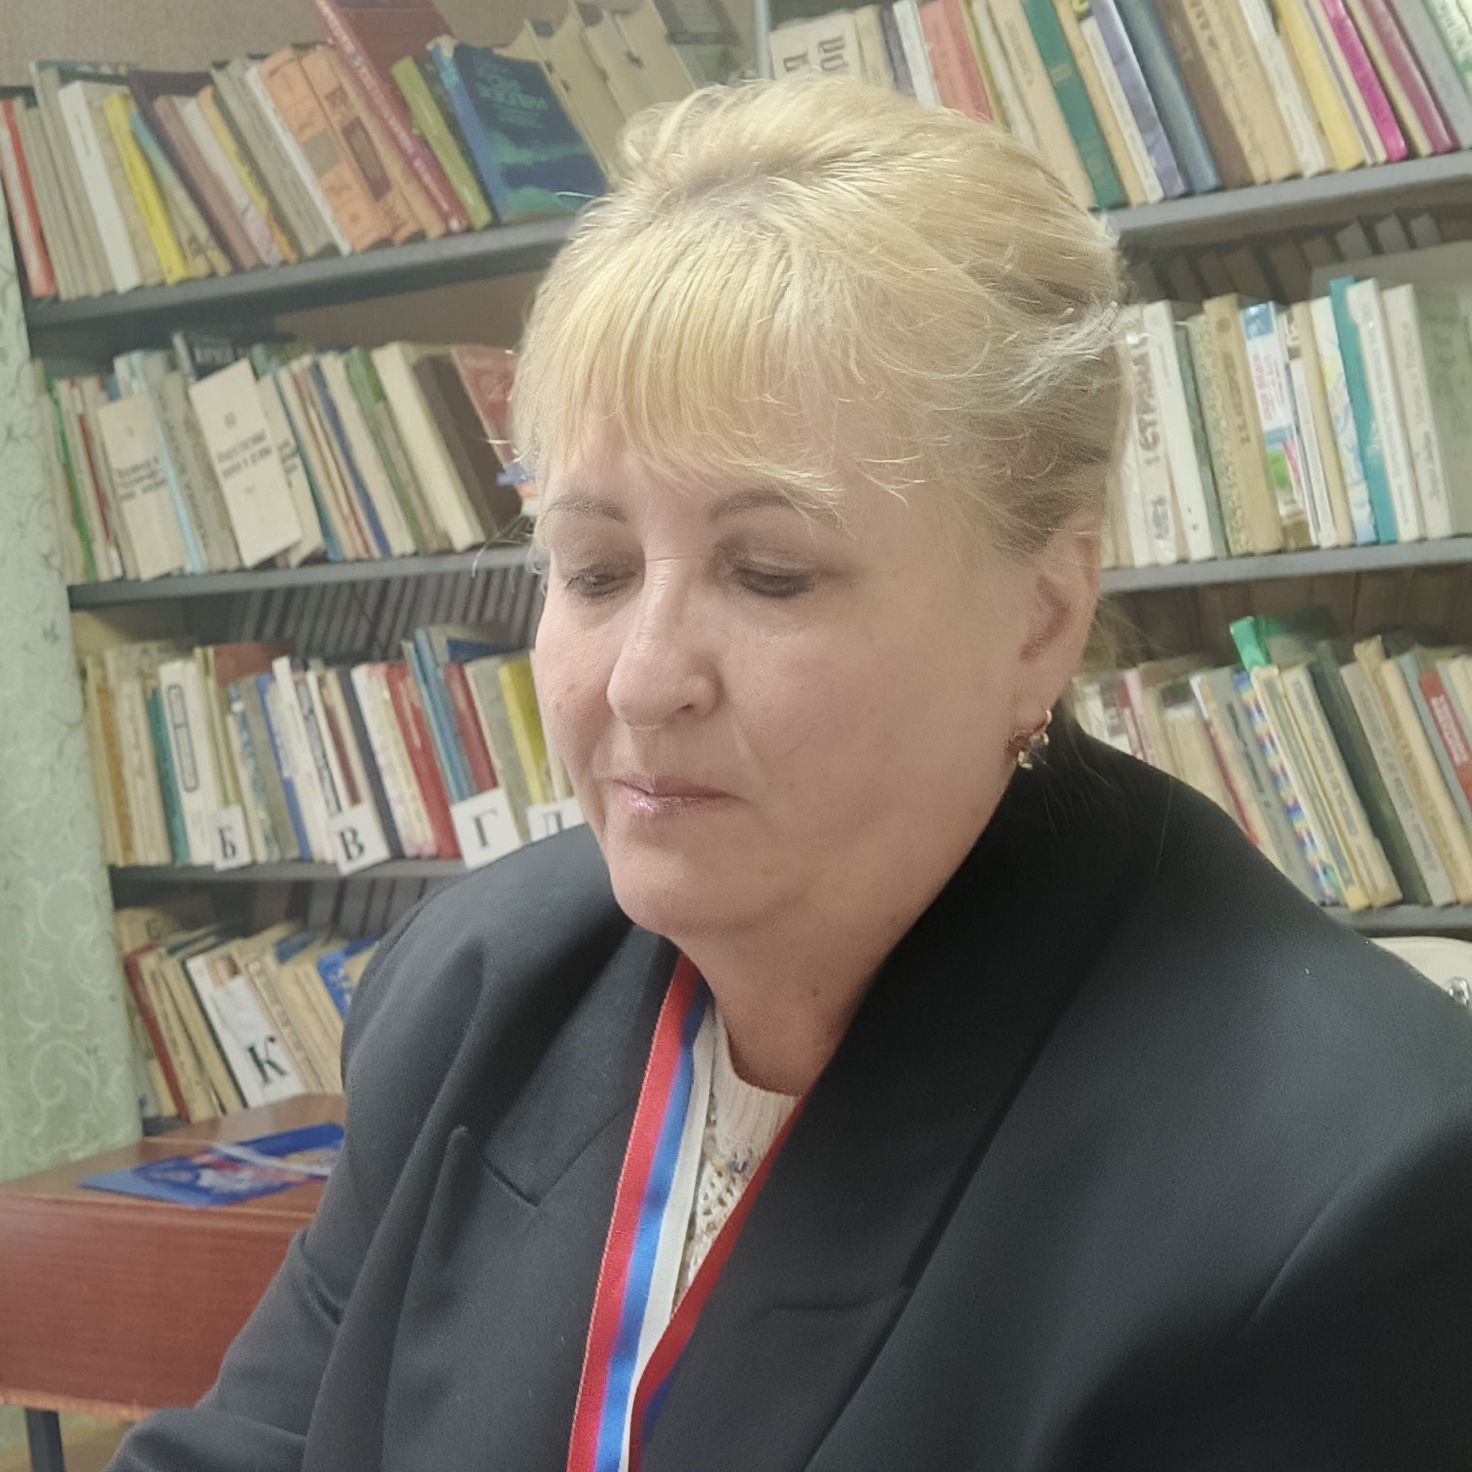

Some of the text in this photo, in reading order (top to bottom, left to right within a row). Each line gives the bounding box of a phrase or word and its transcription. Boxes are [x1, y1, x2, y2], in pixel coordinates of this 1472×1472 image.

[217, 824, 237, 860] Б
[337, 826, 365, 862] В
[472, 808, 499, 848] Г
[248, 1036, 289, 1085] К
